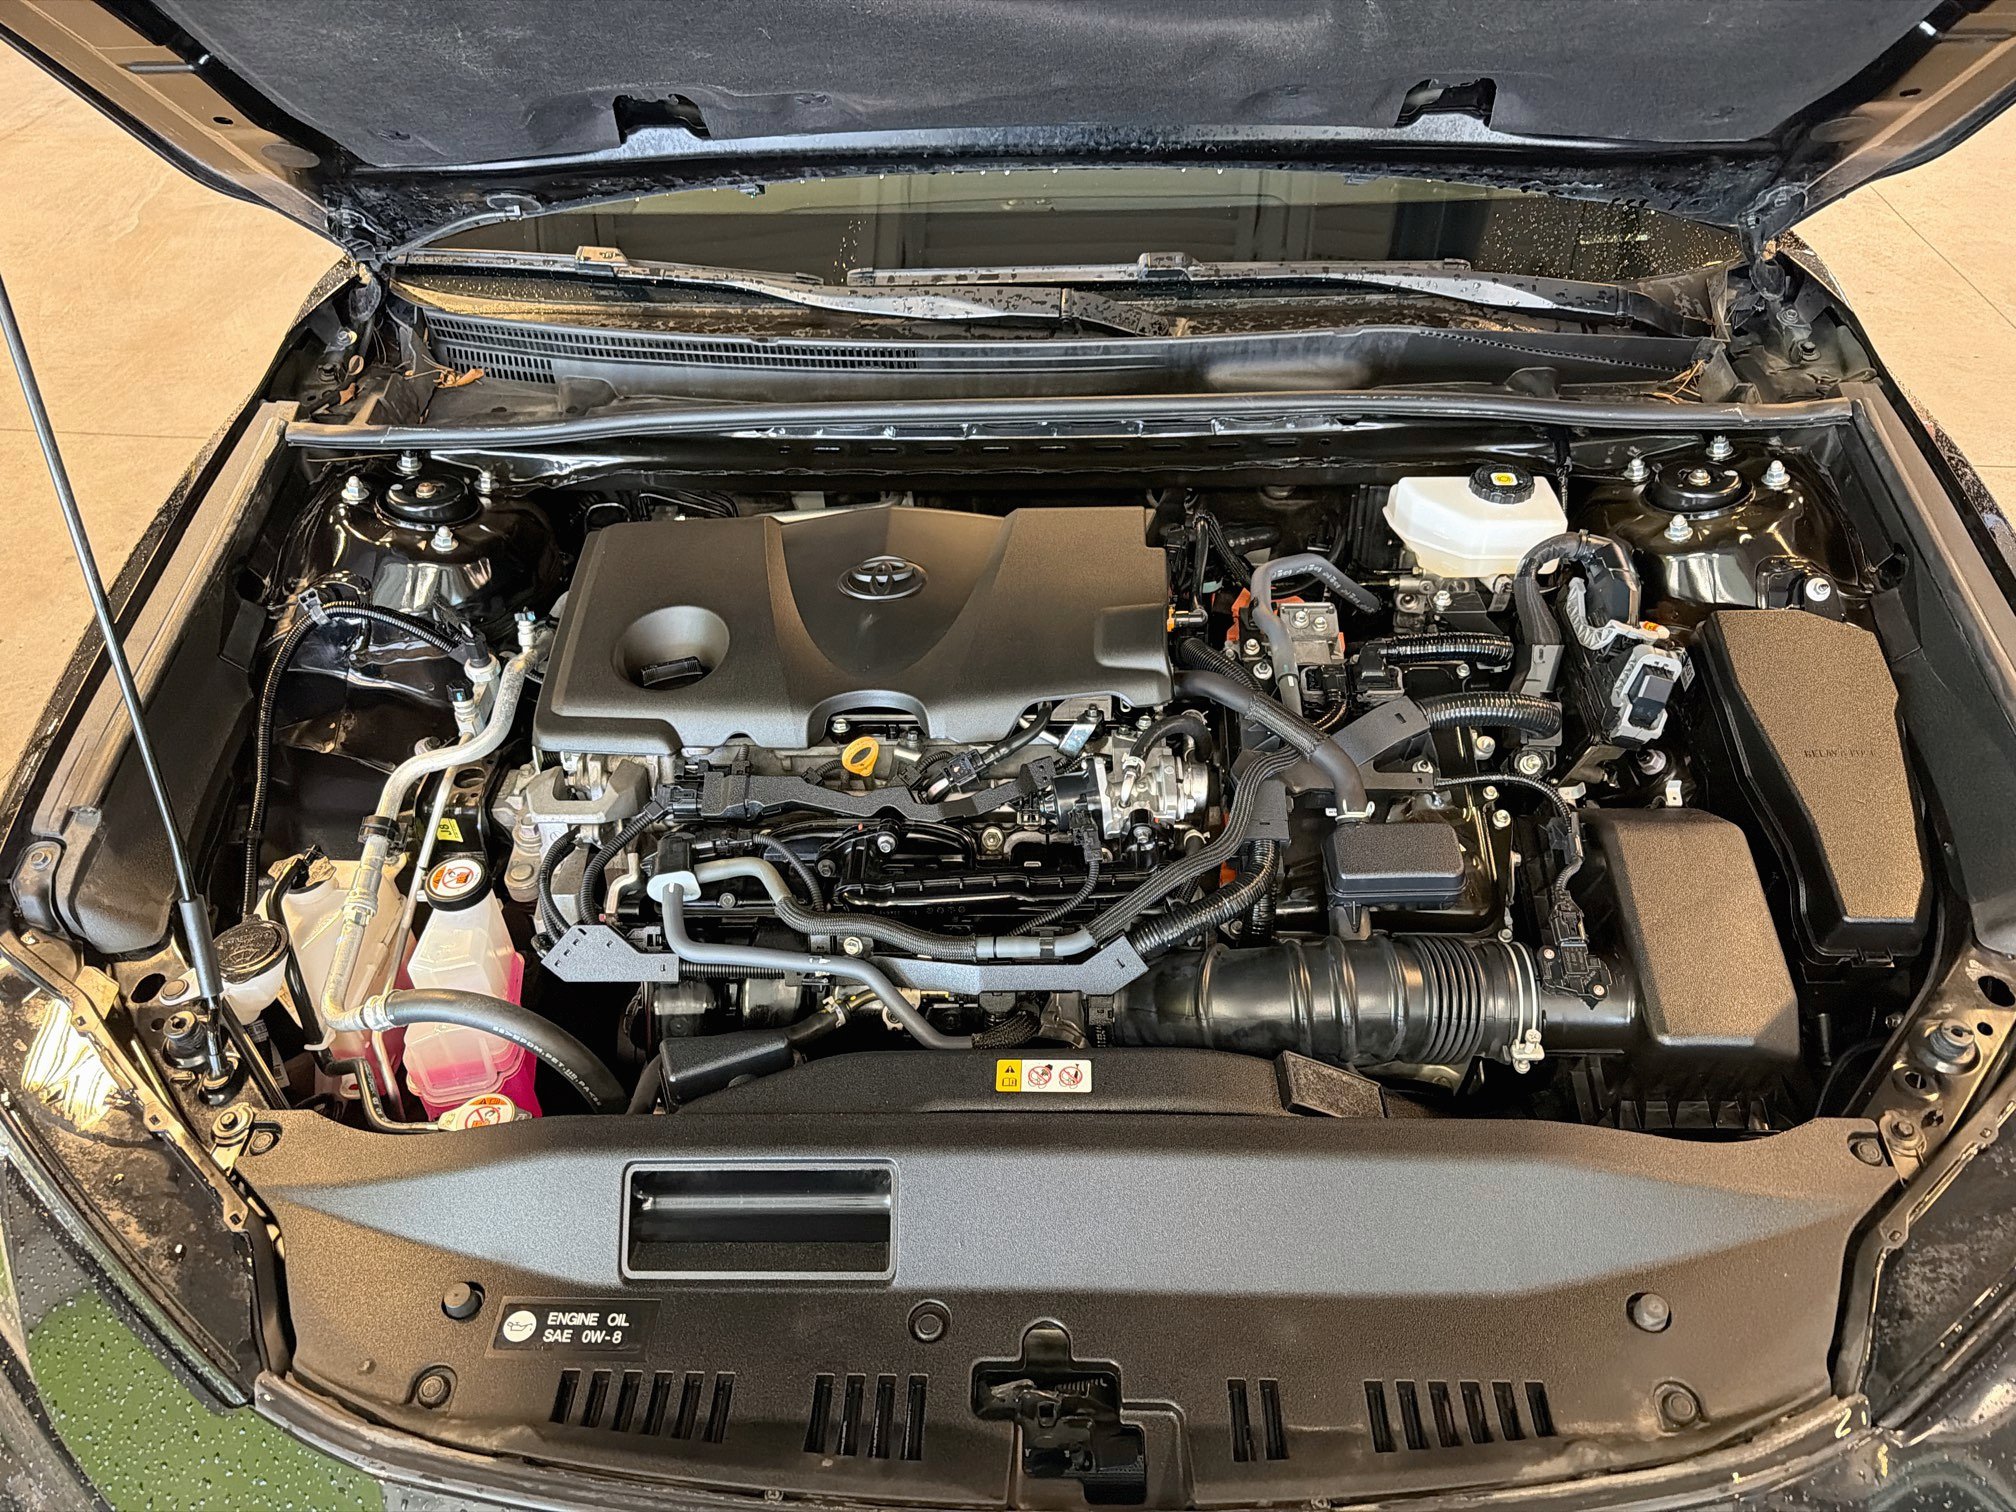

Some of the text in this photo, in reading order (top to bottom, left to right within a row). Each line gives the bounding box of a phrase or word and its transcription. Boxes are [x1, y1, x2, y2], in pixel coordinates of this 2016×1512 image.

[547, 1311, 630, 1327] ENGINE OIL
[542, 1328, 622, 1344] SAE 0W-8
